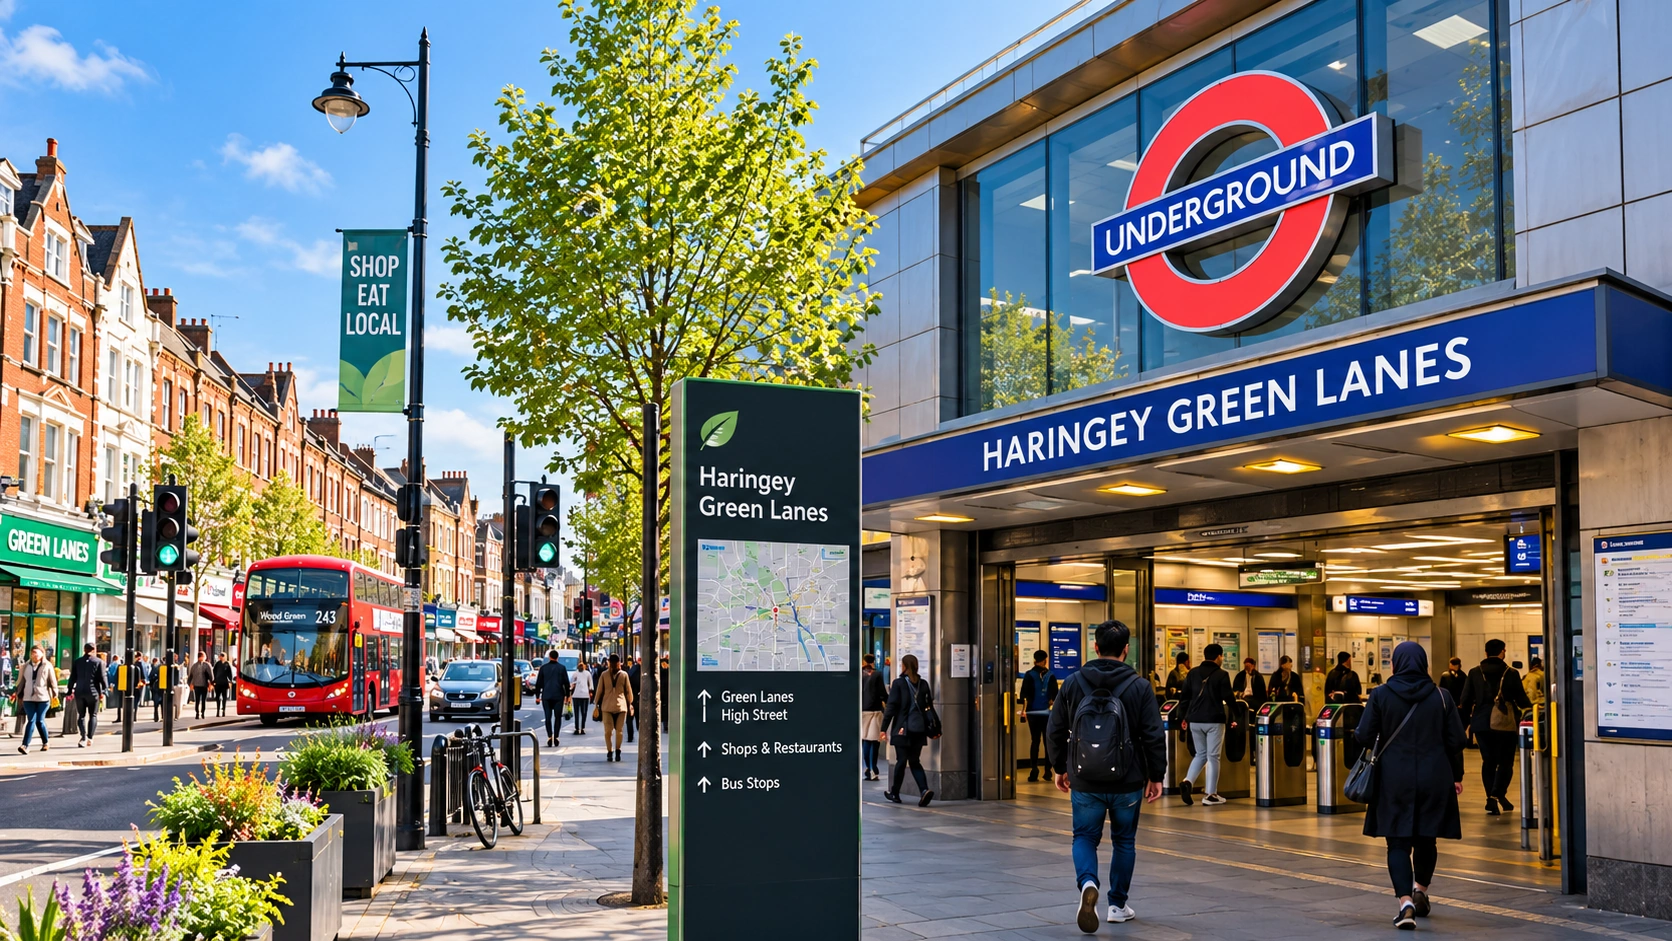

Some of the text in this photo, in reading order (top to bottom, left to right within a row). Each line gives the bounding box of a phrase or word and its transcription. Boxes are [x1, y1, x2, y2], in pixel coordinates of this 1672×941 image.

[1105, 140, 1355, 256] UNDERGROUND
[350, 255, 400, 277] SHOP
[357, 283, 390, 306] EAT
[346, 312, 401, 335] LOCAL
[982, 336, 1472, 471] HARINGEY GREEN LANES
[700, 465, 796, 496] Haringey
[699, 495, 828, 522] Green Lanes
[8, 528, 89, 563] GREEN LANES
[315, 610, 336, 624] 243
[721, 690, 794, 703] Green Lanes
[721, 708, 788, 724] High Street
[721, 741, 842, 758] Shops & Restaurants
[721, 776, 780, 791] Bus Stops
